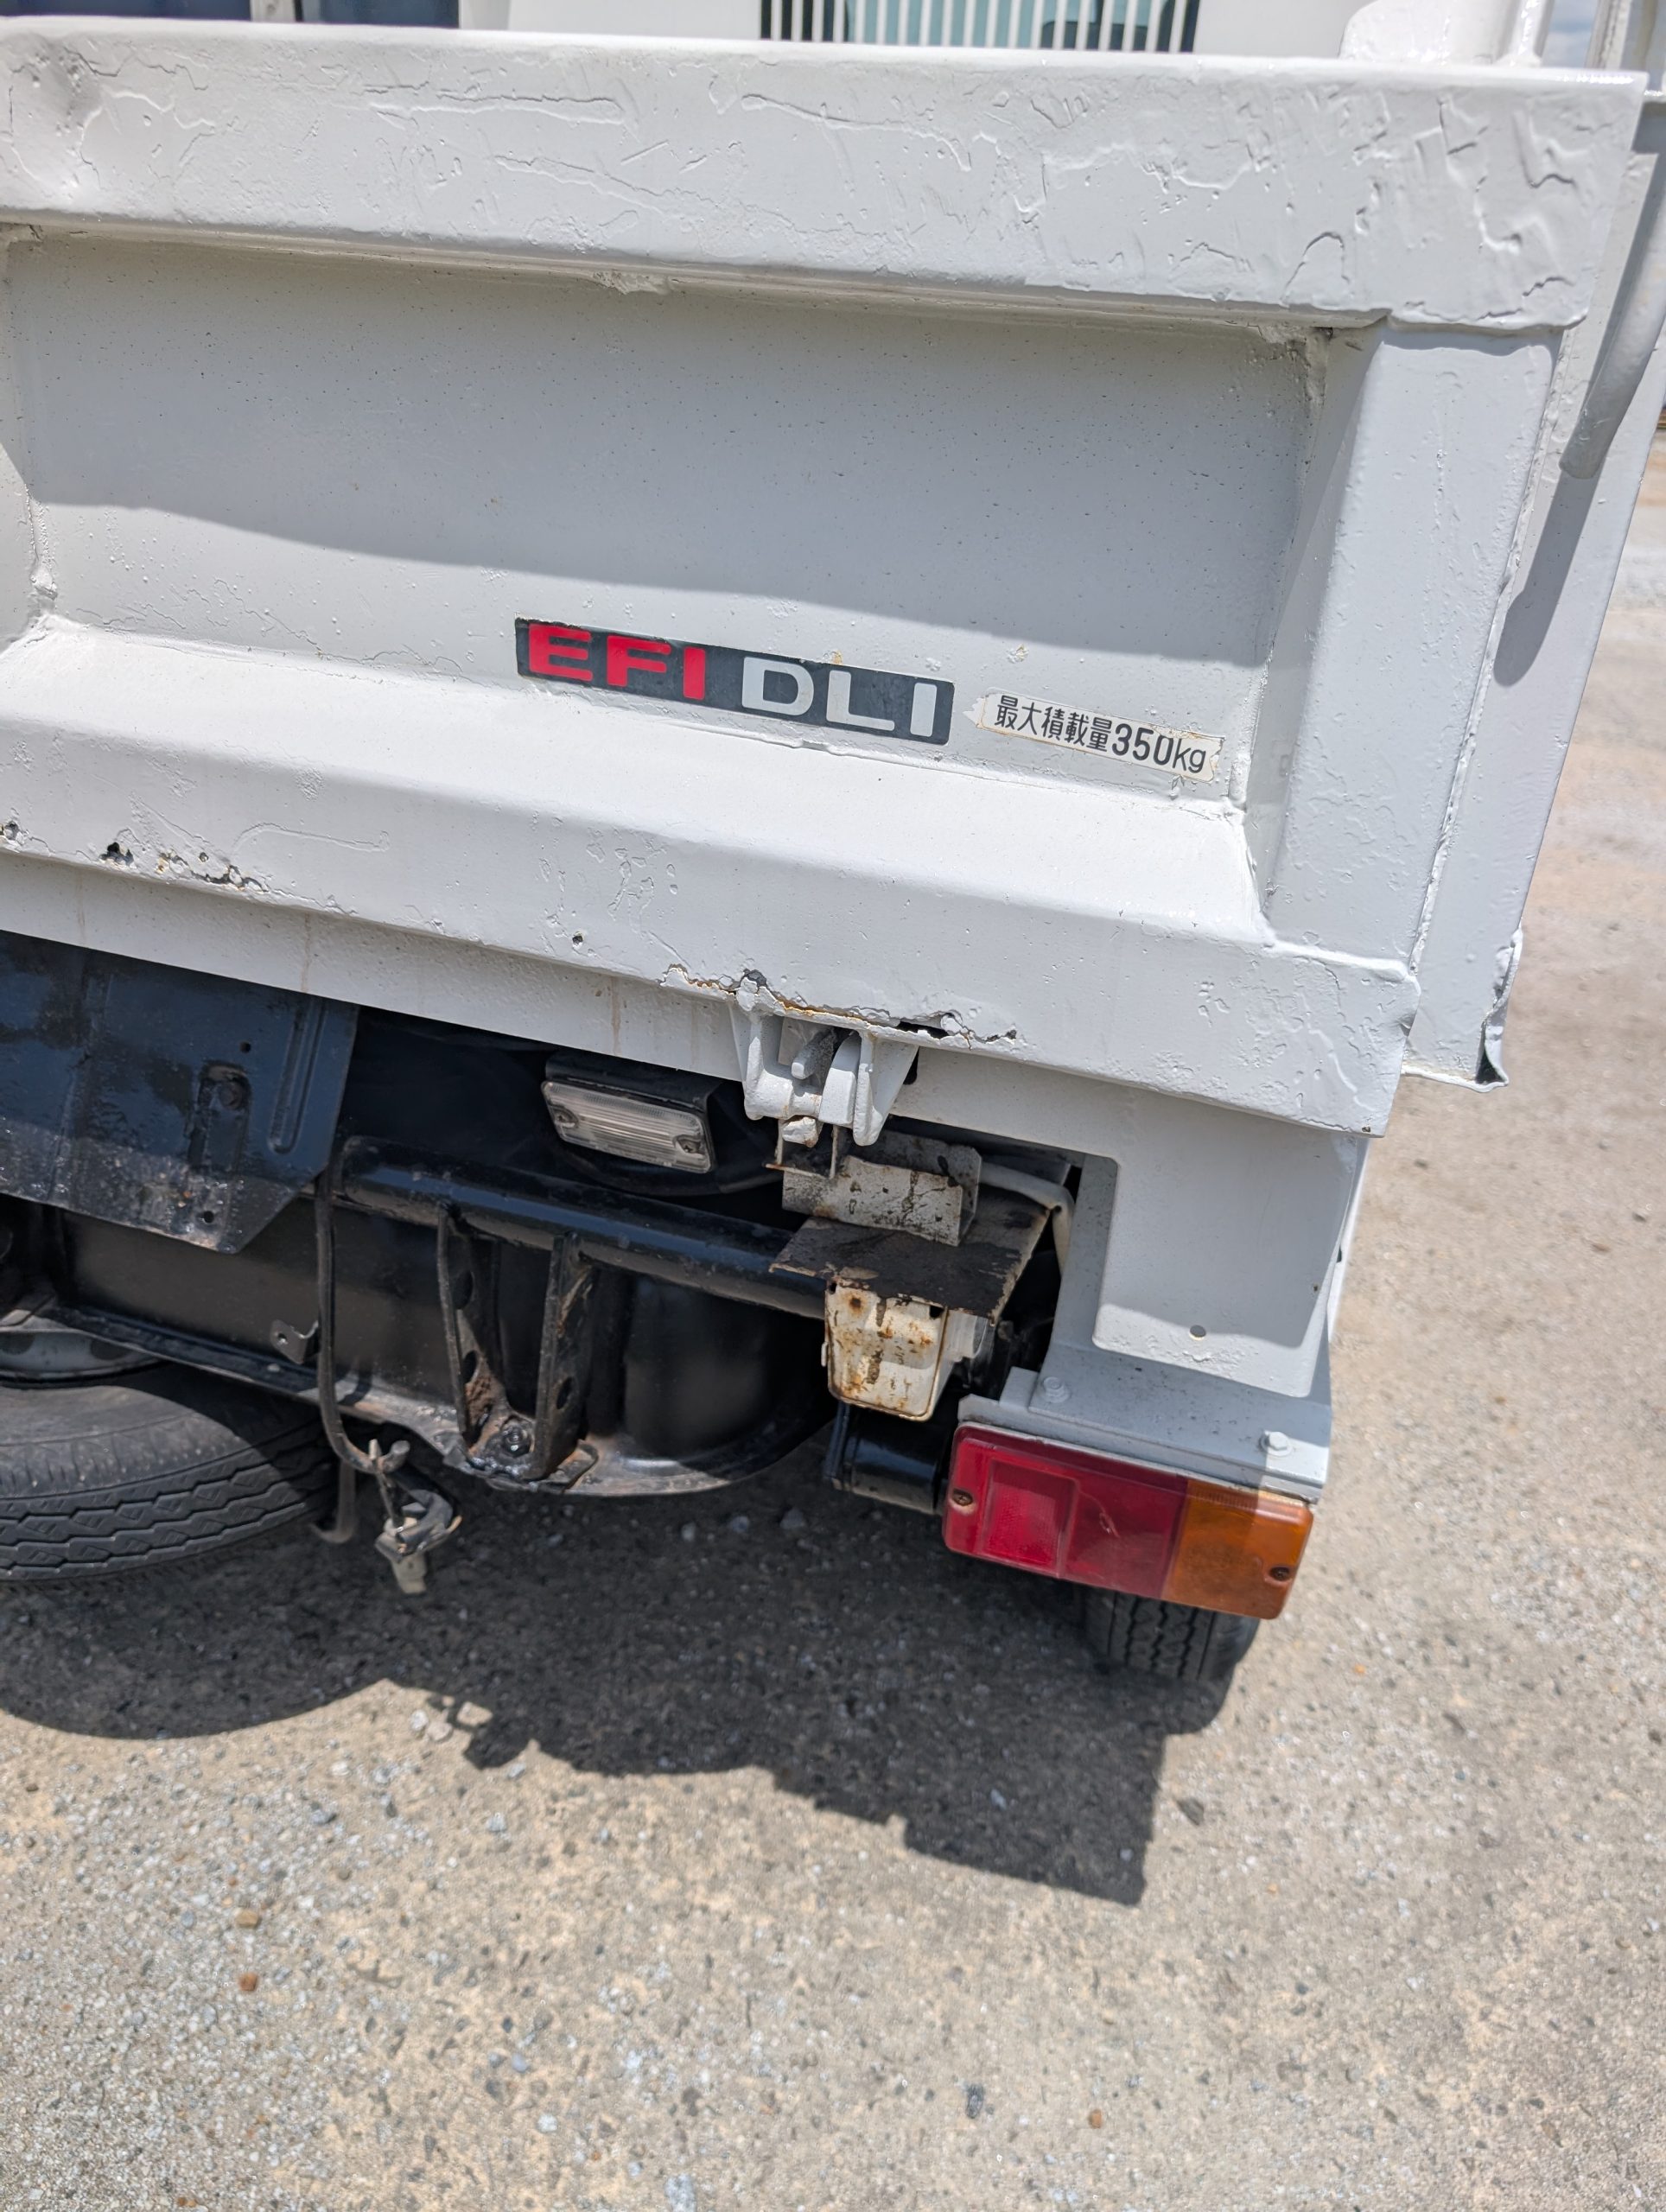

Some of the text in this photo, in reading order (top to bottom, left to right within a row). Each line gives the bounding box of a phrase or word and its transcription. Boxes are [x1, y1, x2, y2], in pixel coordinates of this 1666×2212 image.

[528, 623, 938, 737] EFI DLI
[994, 695, 1206, 773] 最大積載量350kg
